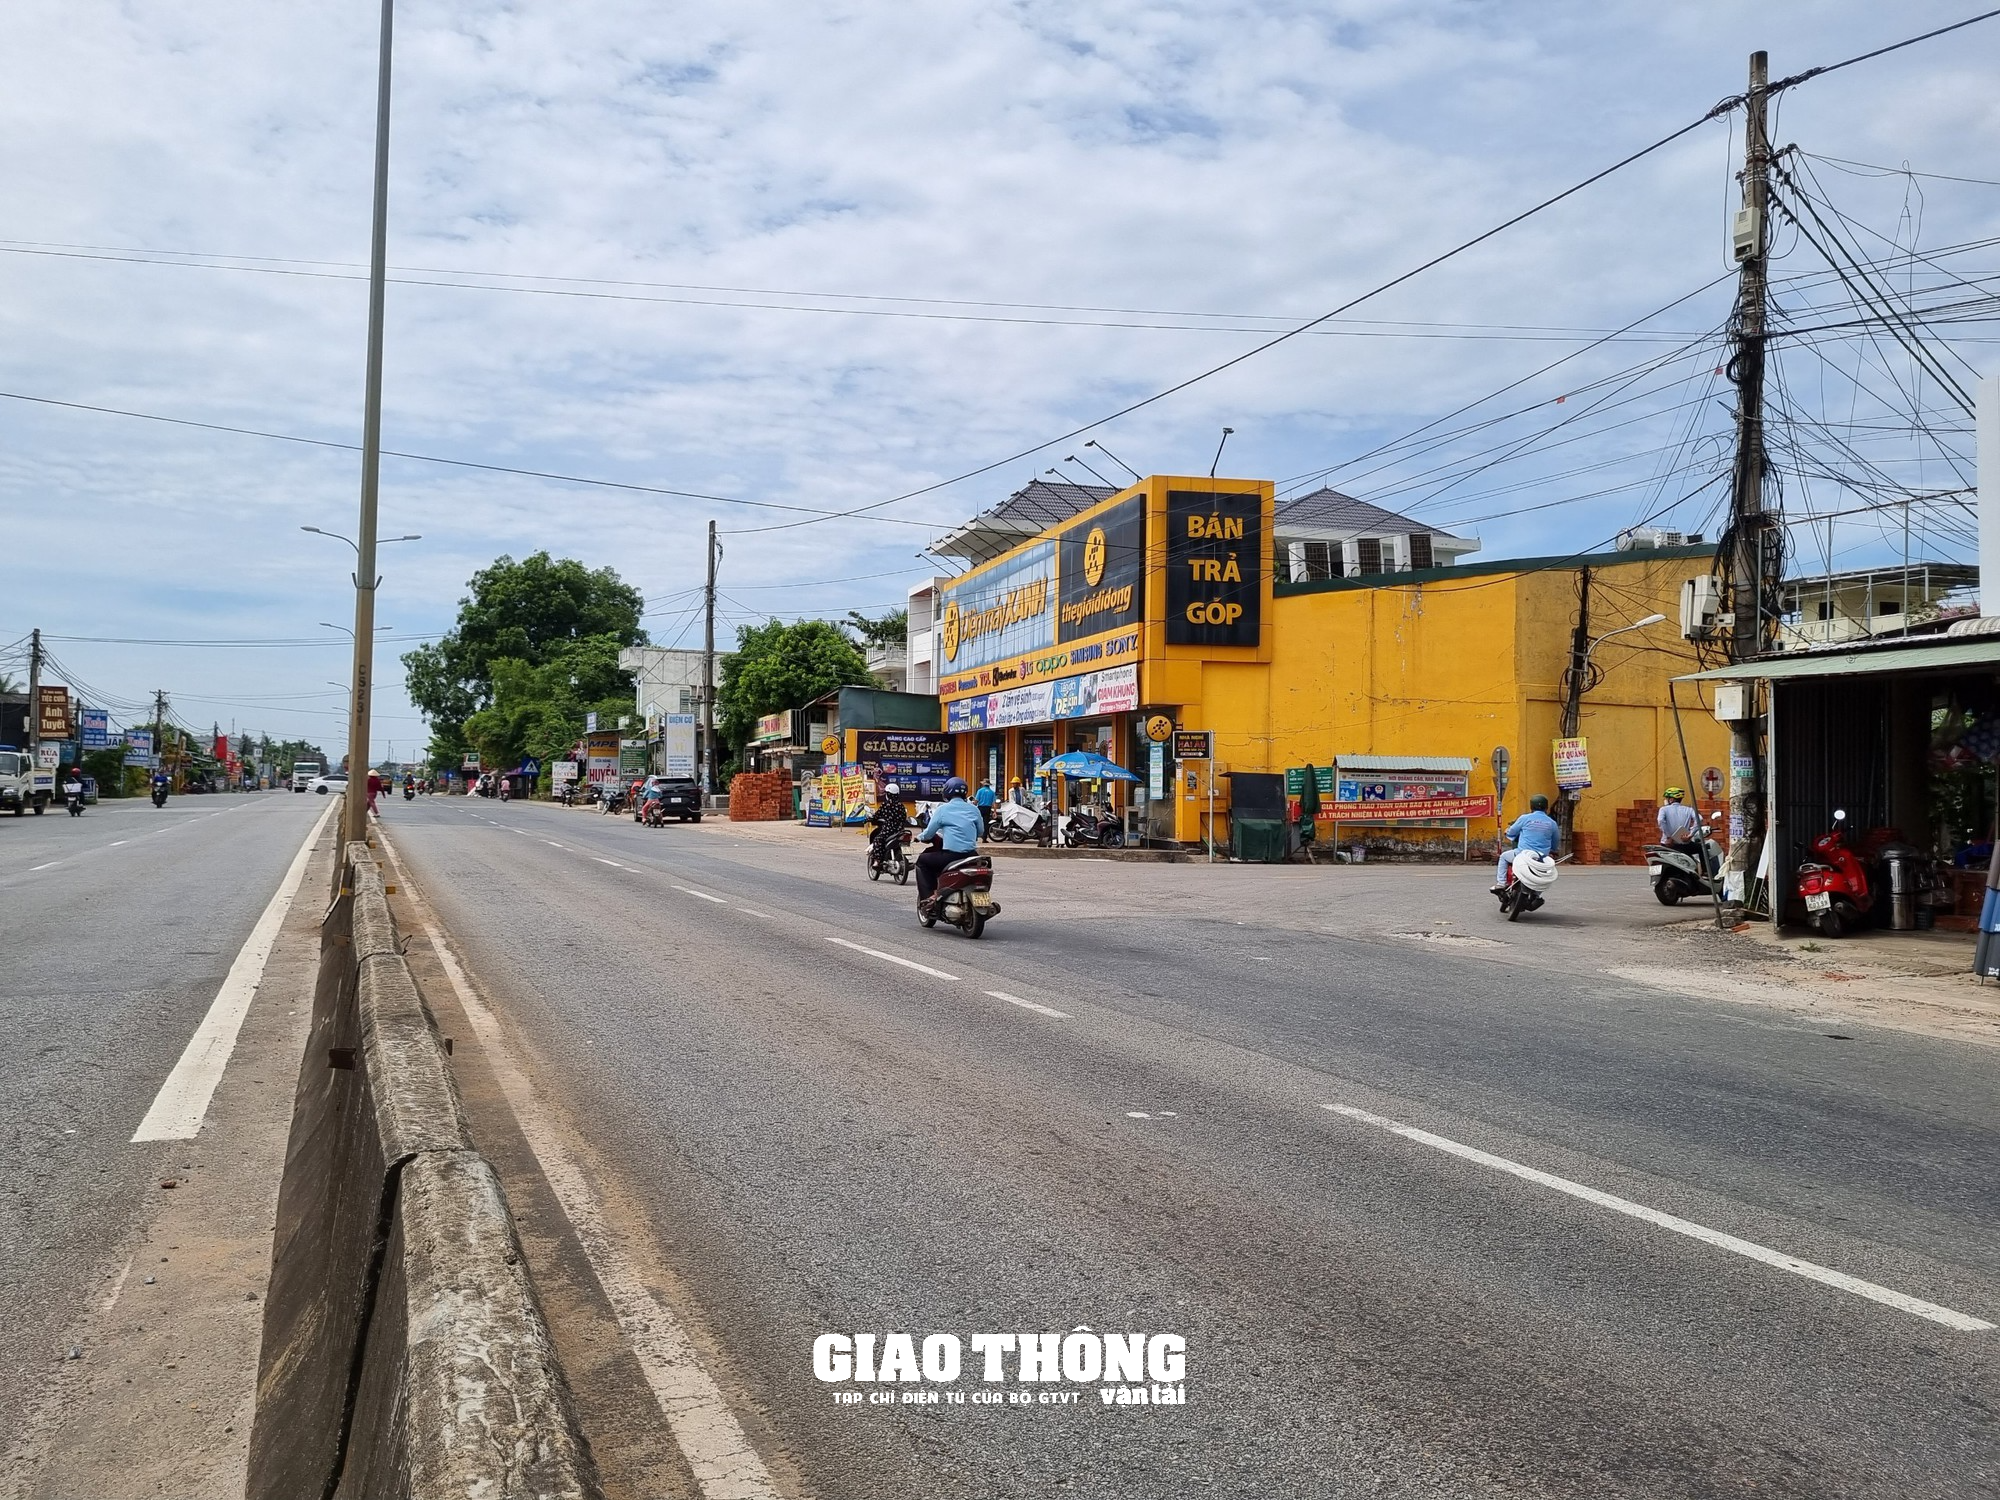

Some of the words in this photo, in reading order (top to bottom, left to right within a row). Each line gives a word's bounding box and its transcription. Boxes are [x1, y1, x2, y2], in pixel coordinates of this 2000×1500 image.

[1188, 512, 1243, 540] BÁN
[1188, 553, 1242, 583] TRẢ
[1062, 584, 1135, 627] thegioididong
[980, 671, 991, 685] TCL
[1026, 663, 1034, 676] LG
[1070, 643, 1103, 666] SAMSUNG
[1105, 634, 1138, 658] SONY
[1101, 667, 1133, 683] Smartphone
[41, 719, 66, 730] Tuyết
[863, 738, 888, 752] GIÁ
[890, 741, 916, 753] BAO
[1329, 811, 1350, 819] TRÁCH
[1351, 810, 1373, 819] NHIỆM
[1374, 810, 1382, 818] VÀ
